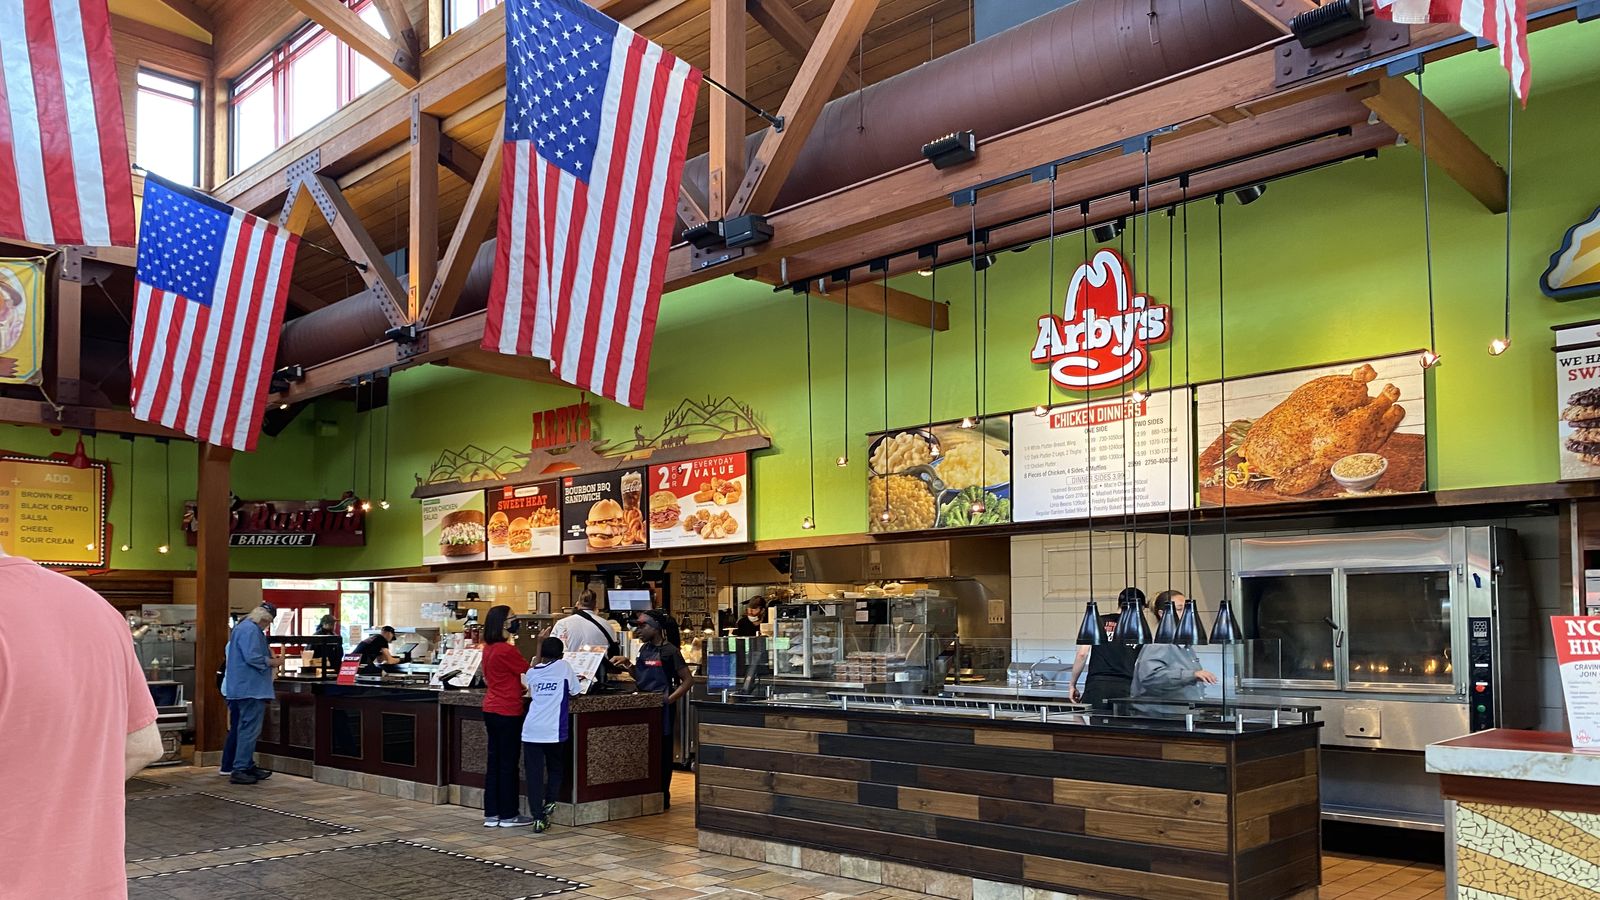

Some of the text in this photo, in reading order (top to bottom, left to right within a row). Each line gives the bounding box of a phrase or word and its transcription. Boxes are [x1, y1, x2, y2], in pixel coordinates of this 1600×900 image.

[1031, 296, 1166, 357] Arby's
[1559, 357, 1582, 367] WE
[1568, 366, 1600, 381] SW
[1053, 401, 1142, 428] CHICKEN DINNERS
[1147, 417, 1164, 425] SIDES
[694, 457, 734, 468] EVERYDAY
[658, 466, 670, 489] 2
[678, 462, 693, 487] $7
[694, 464, 734, 478] VALUE
[1094, 473, 1111, 482] SIDES
[565, 481, 611, 496] BOURBON BBQ
[21, 491, 52, 500] BROWN
[565, 492, 601, 504] SANDWICH
[21, 502, 49, 510] BLACK
[439, 503, 458, 511] CHICKEN
[497, 495, 548, 510] SWEET HEAT
[20, 513, 48, 522] SALSA
[20, 525, 54, 533] CHEESE
[20, 536, 75, 545] SOUR CREAM
[237, 534, 305, 546] BARBECUE
